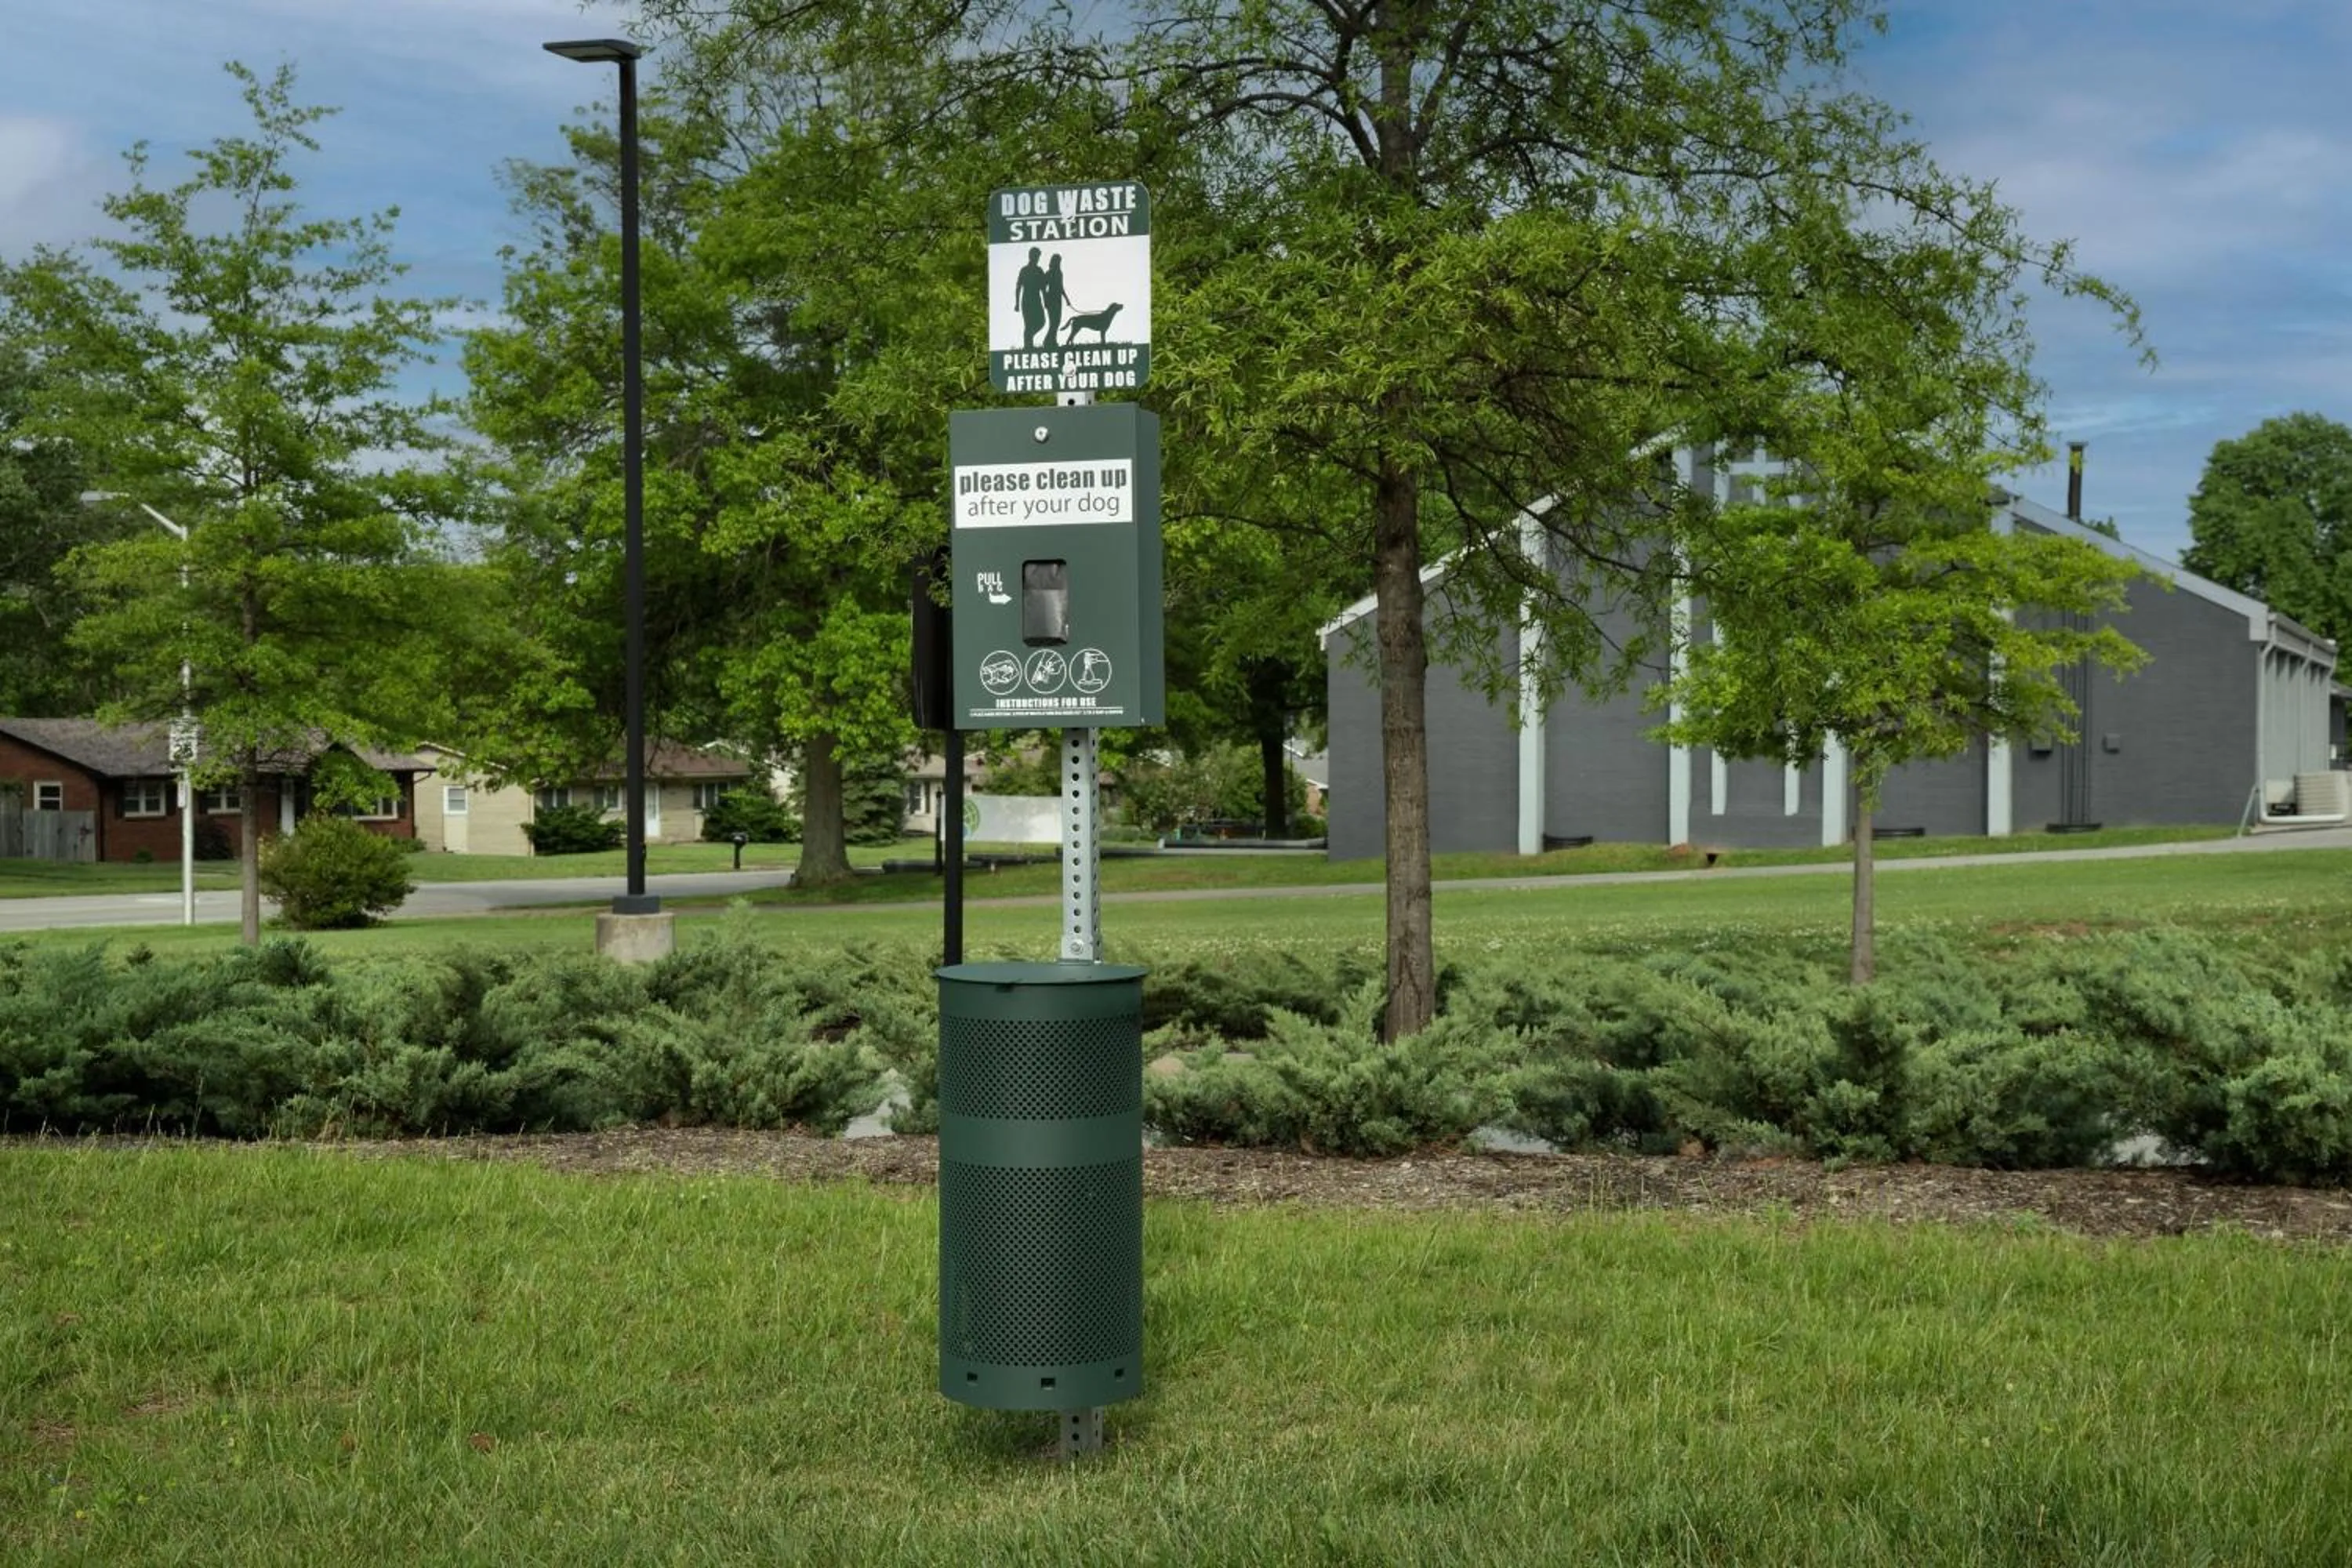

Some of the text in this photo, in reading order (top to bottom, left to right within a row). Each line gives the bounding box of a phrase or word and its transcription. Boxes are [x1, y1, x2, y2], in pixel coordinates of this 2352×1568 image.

[1001, 185, 1136, 216] DOG WASTE
[1010, 215, 1129, 241] STATION
[1004, 348, 1138, 371] PLEASE CLEAN UP
[1007, 370, 1136, 392] AFTER YOUR DOG
[960, 468, 1127, 495] please clean up
[967, 492, 1120, 519] after your dog
[977, 572, 1002, 585] PULL
[995, 696, 1097, 708] INSTRUCTIONS FOR USE
